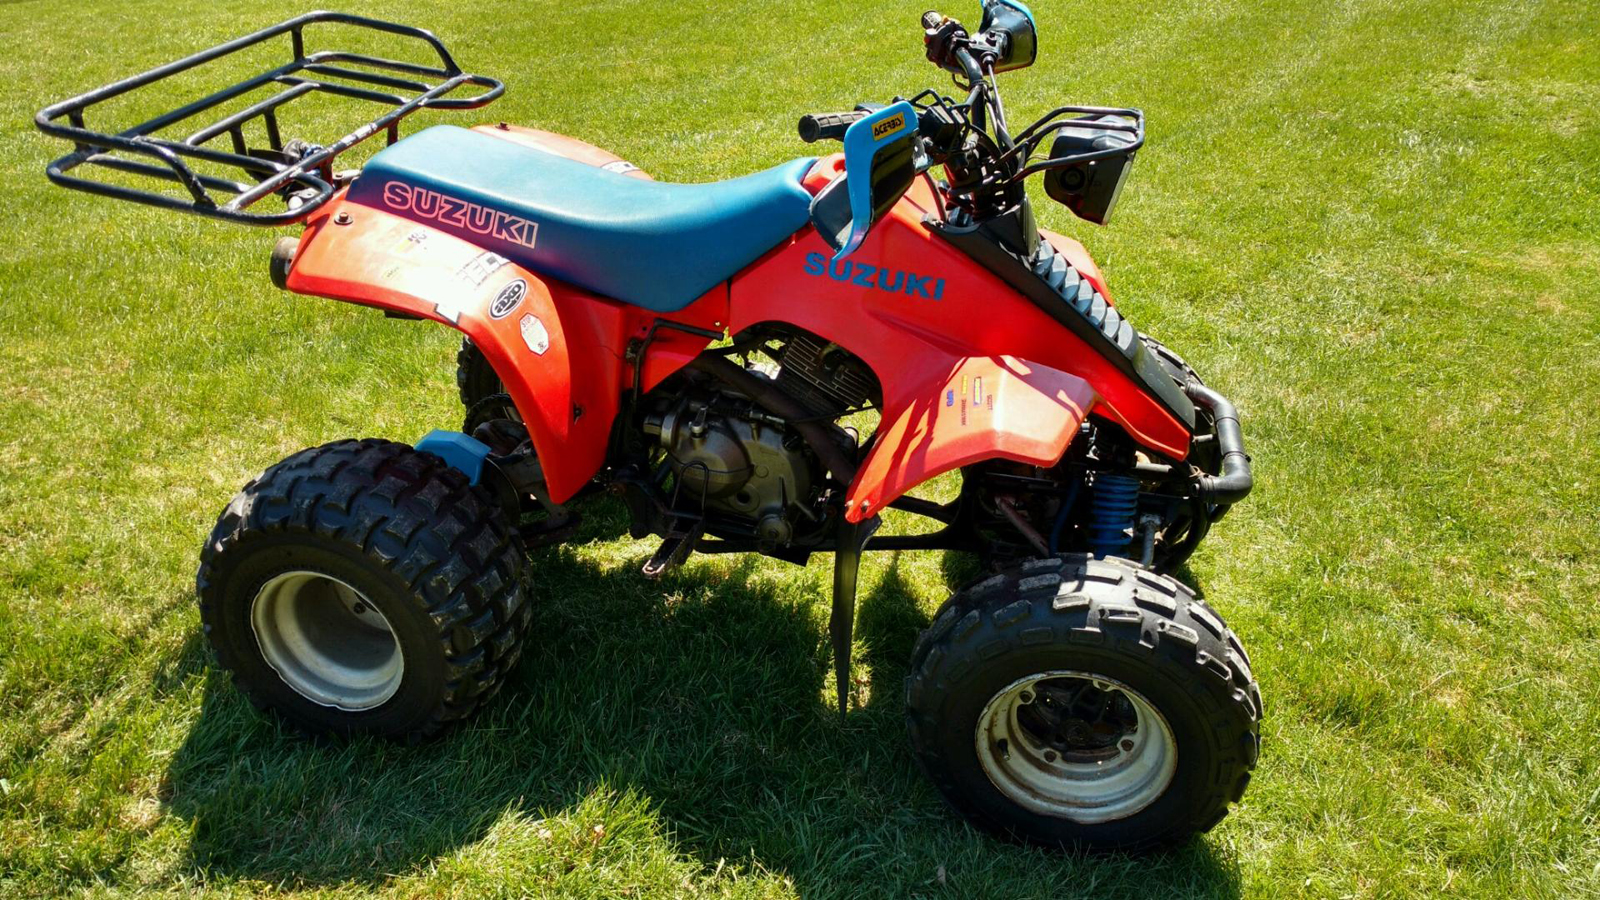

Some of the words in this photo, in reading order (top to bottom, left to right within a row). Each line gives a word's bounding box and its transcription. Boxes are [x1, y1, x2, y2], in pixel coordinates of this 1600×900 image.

[874, 117, 902, 137] ACERBIS
[384, 181, 539, 249] SUZUKI
[803, 252, 946, 300] SUZUKI
